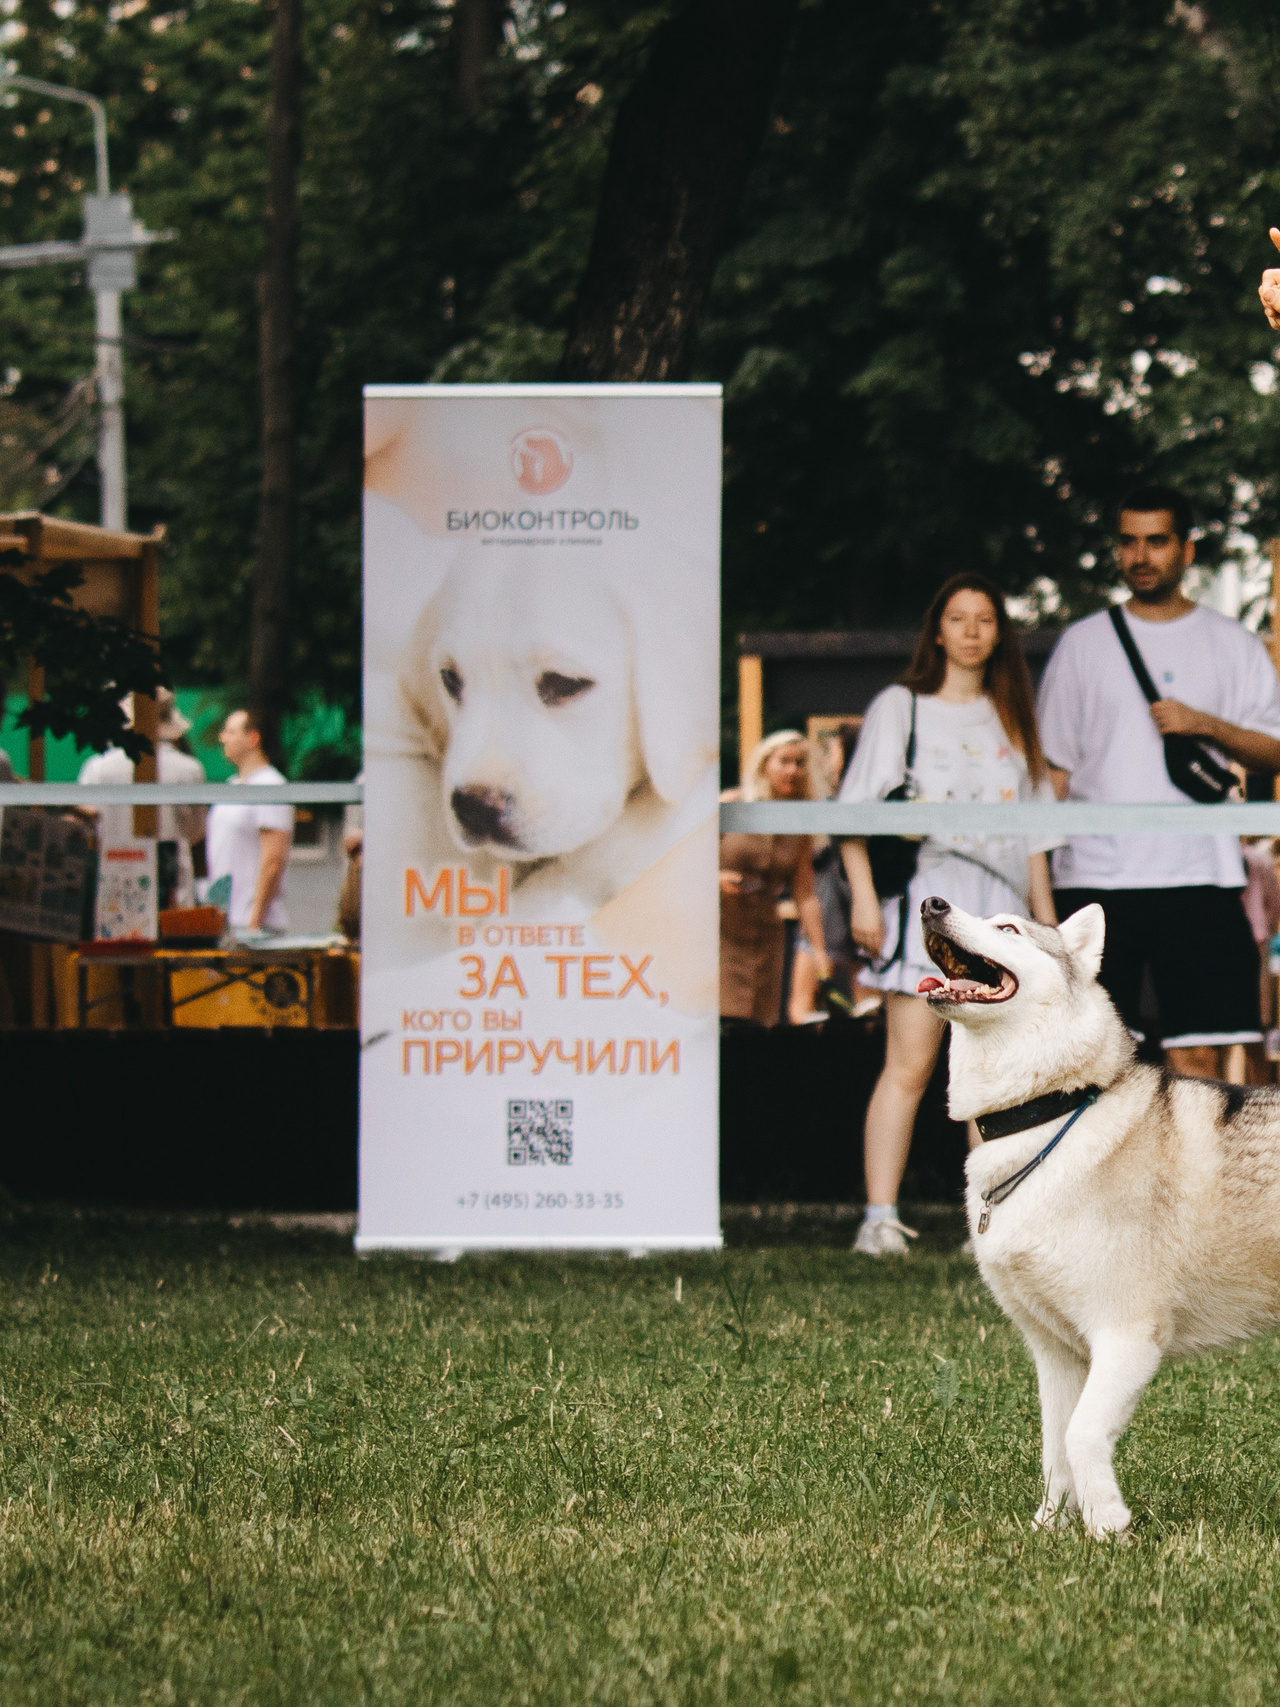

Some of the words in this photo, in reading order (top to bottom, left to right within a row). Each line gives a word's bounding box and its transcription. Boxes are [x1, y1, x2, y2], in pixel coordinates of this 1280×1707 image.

[447, 510, 640, 531] БИОКОНТРОЛЬ
[404, 868, 509, 917] МЫ
[457, 924, 475, 946] В
[483, 924, 585, 946] ОТВЕТЕ
[458, 954, 527, 1000] ЗА
[544, 954, 668, 1006] ТЕХ,
[402, 1010, 472, 1031] КОГО
[482, 1010, 522, 1031] ВЫ
[402, 1039, 680, 1075] ПРИРУЧИЛИ
[456, 1192, 479, 1209] +7
[484, 1192, 530, 1211] (495)
[534, 1192, 625, 1210] 260-33-35
